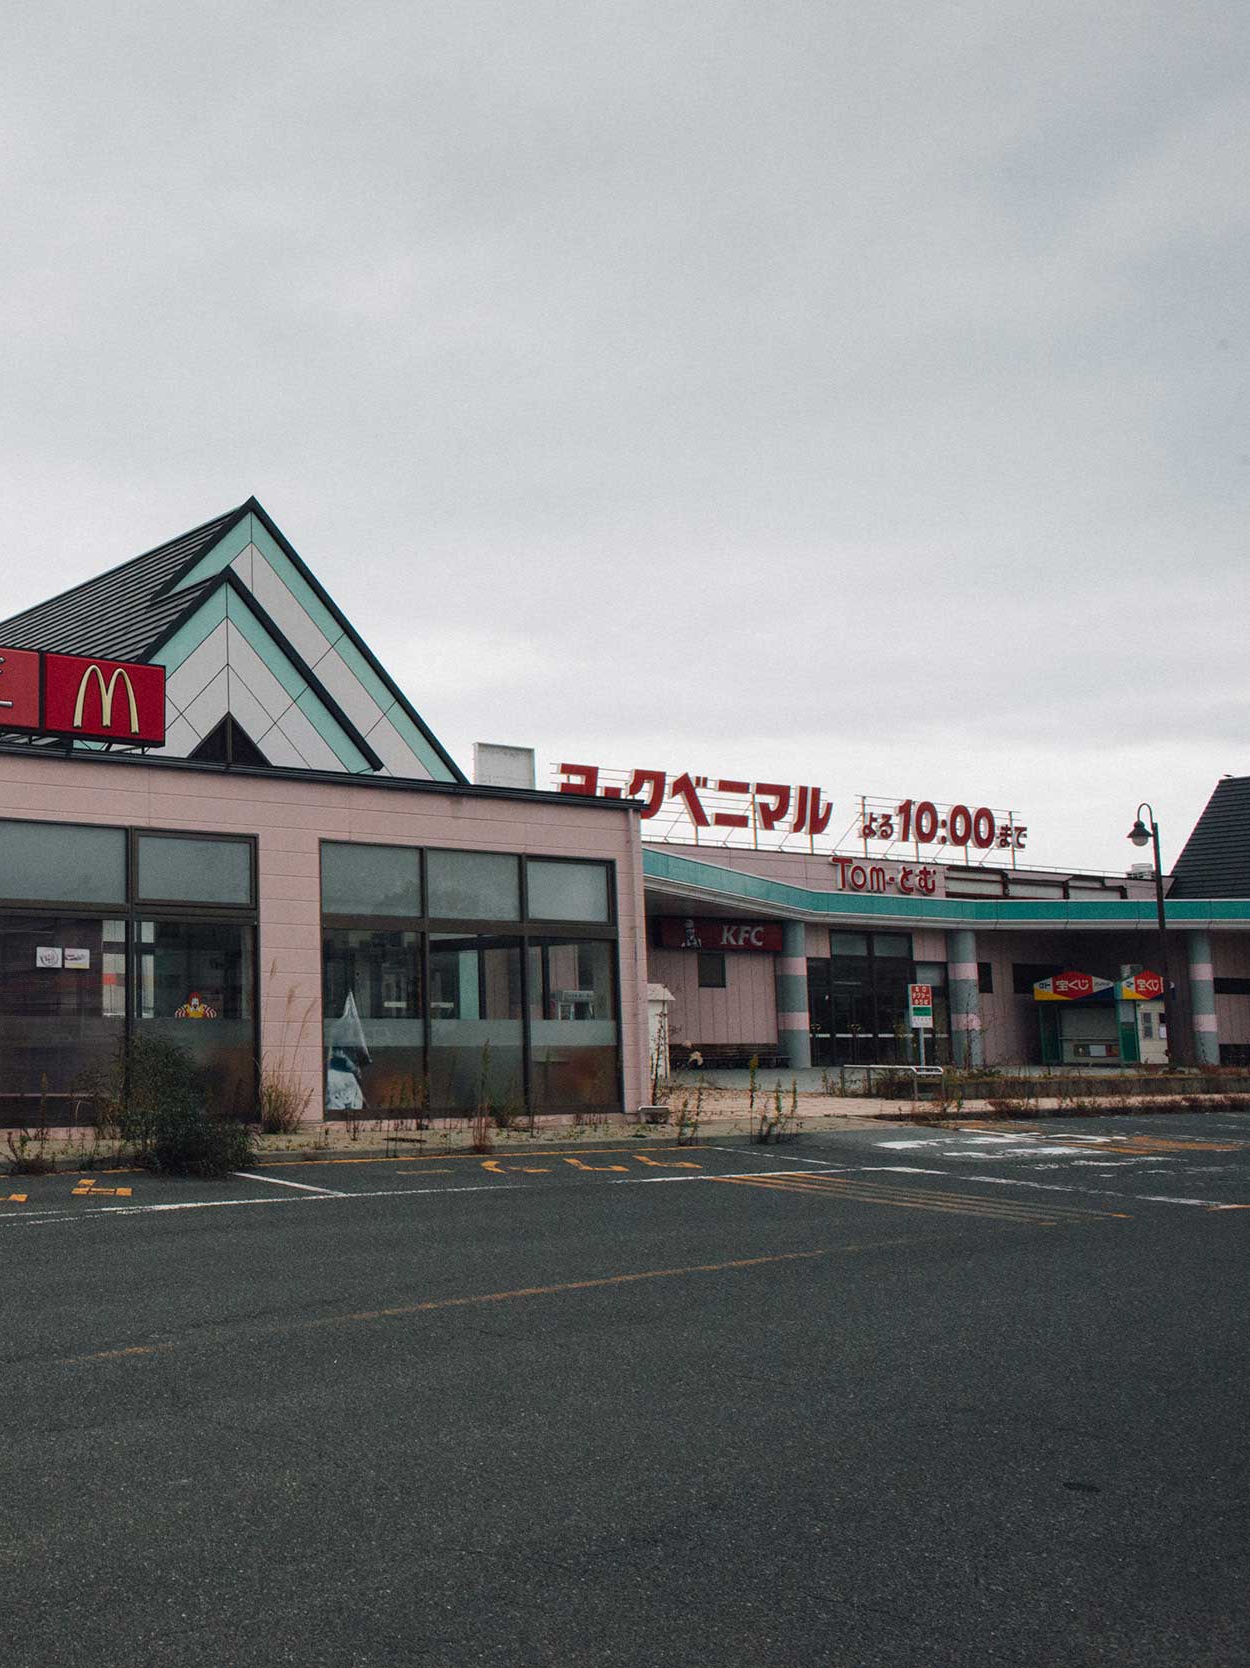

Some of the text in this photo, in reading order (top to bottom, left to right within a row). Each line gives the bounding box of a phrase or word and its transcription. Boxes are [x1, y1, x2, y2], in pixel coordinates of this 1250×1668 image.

[556, 762, 834, 835] ヨークベニマル
[720, 924, 765, 946] KFC
[1056, 979, 1090, 992] 宝くじ
[1136, 979, 1159, 991] 宝くじ
